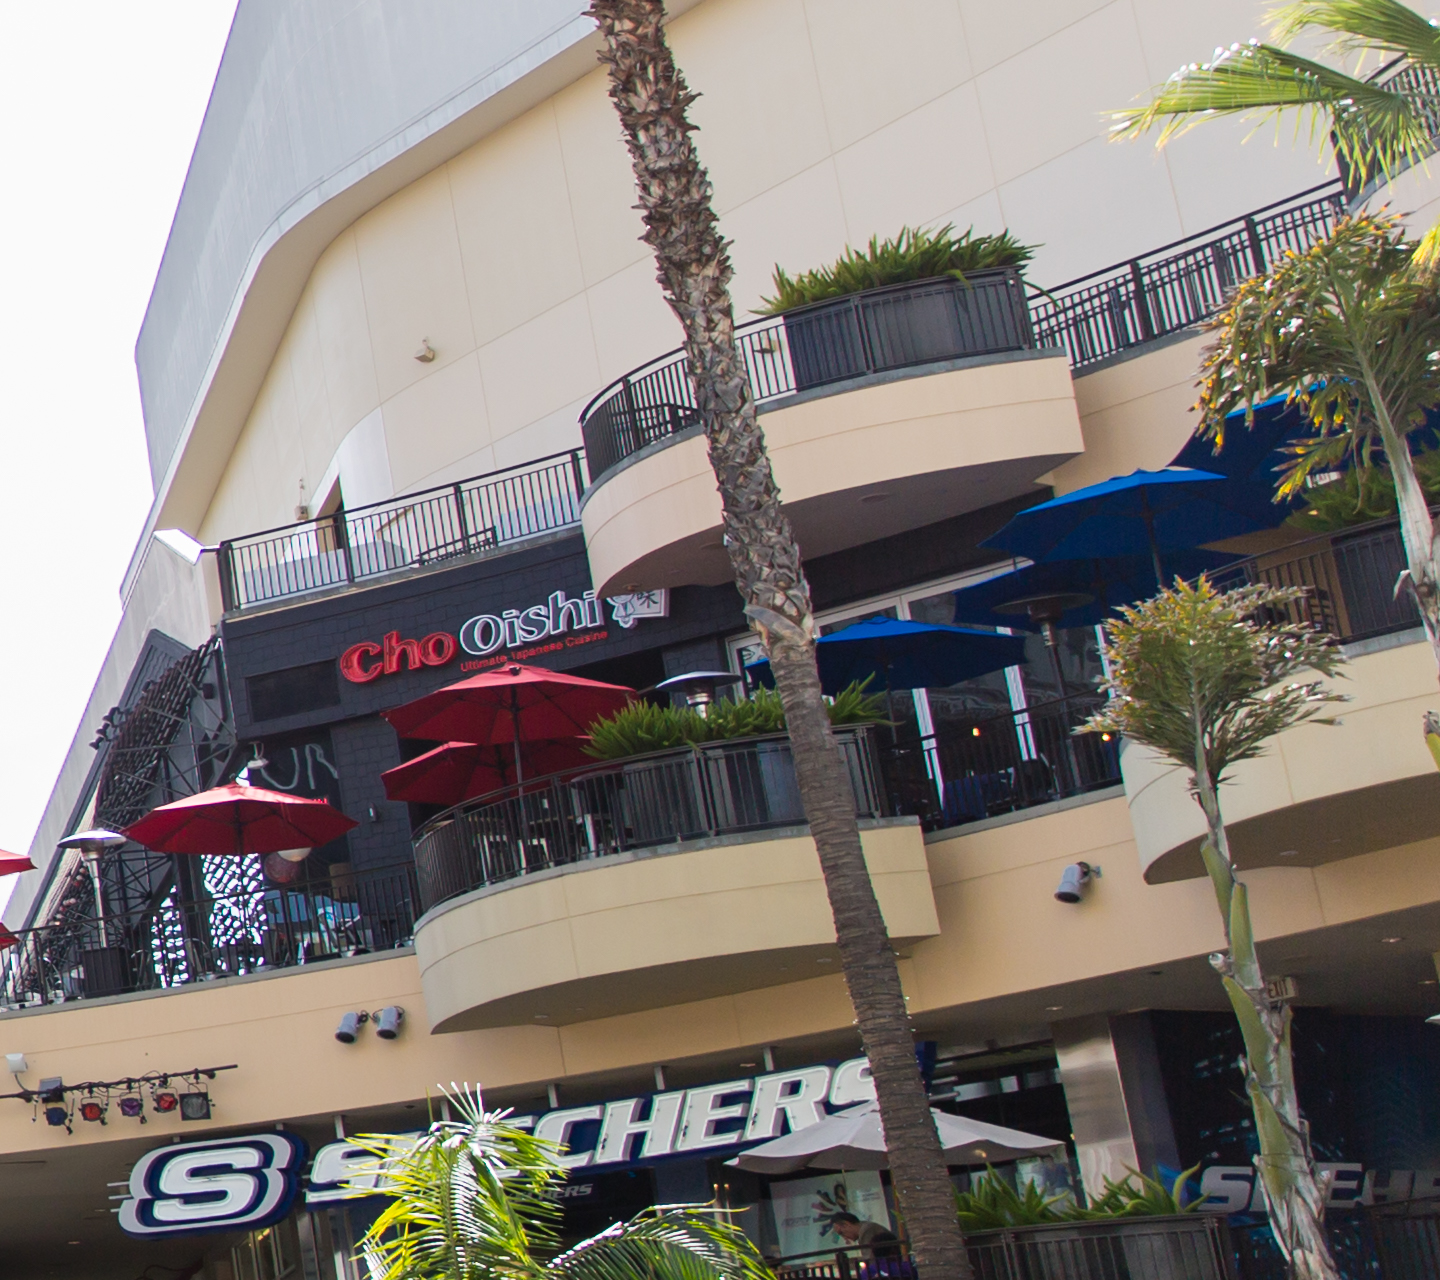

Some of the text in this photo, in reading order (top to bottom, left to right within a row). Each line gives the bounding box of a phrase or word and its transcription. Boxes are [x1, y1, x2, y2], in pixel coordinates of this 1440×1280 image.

[459, 590, 606, 656] Oishi
[460, 630, 609, 672] Ultimate Japanese Cuisine
[306, 1056, 878, 1204] SCHER
